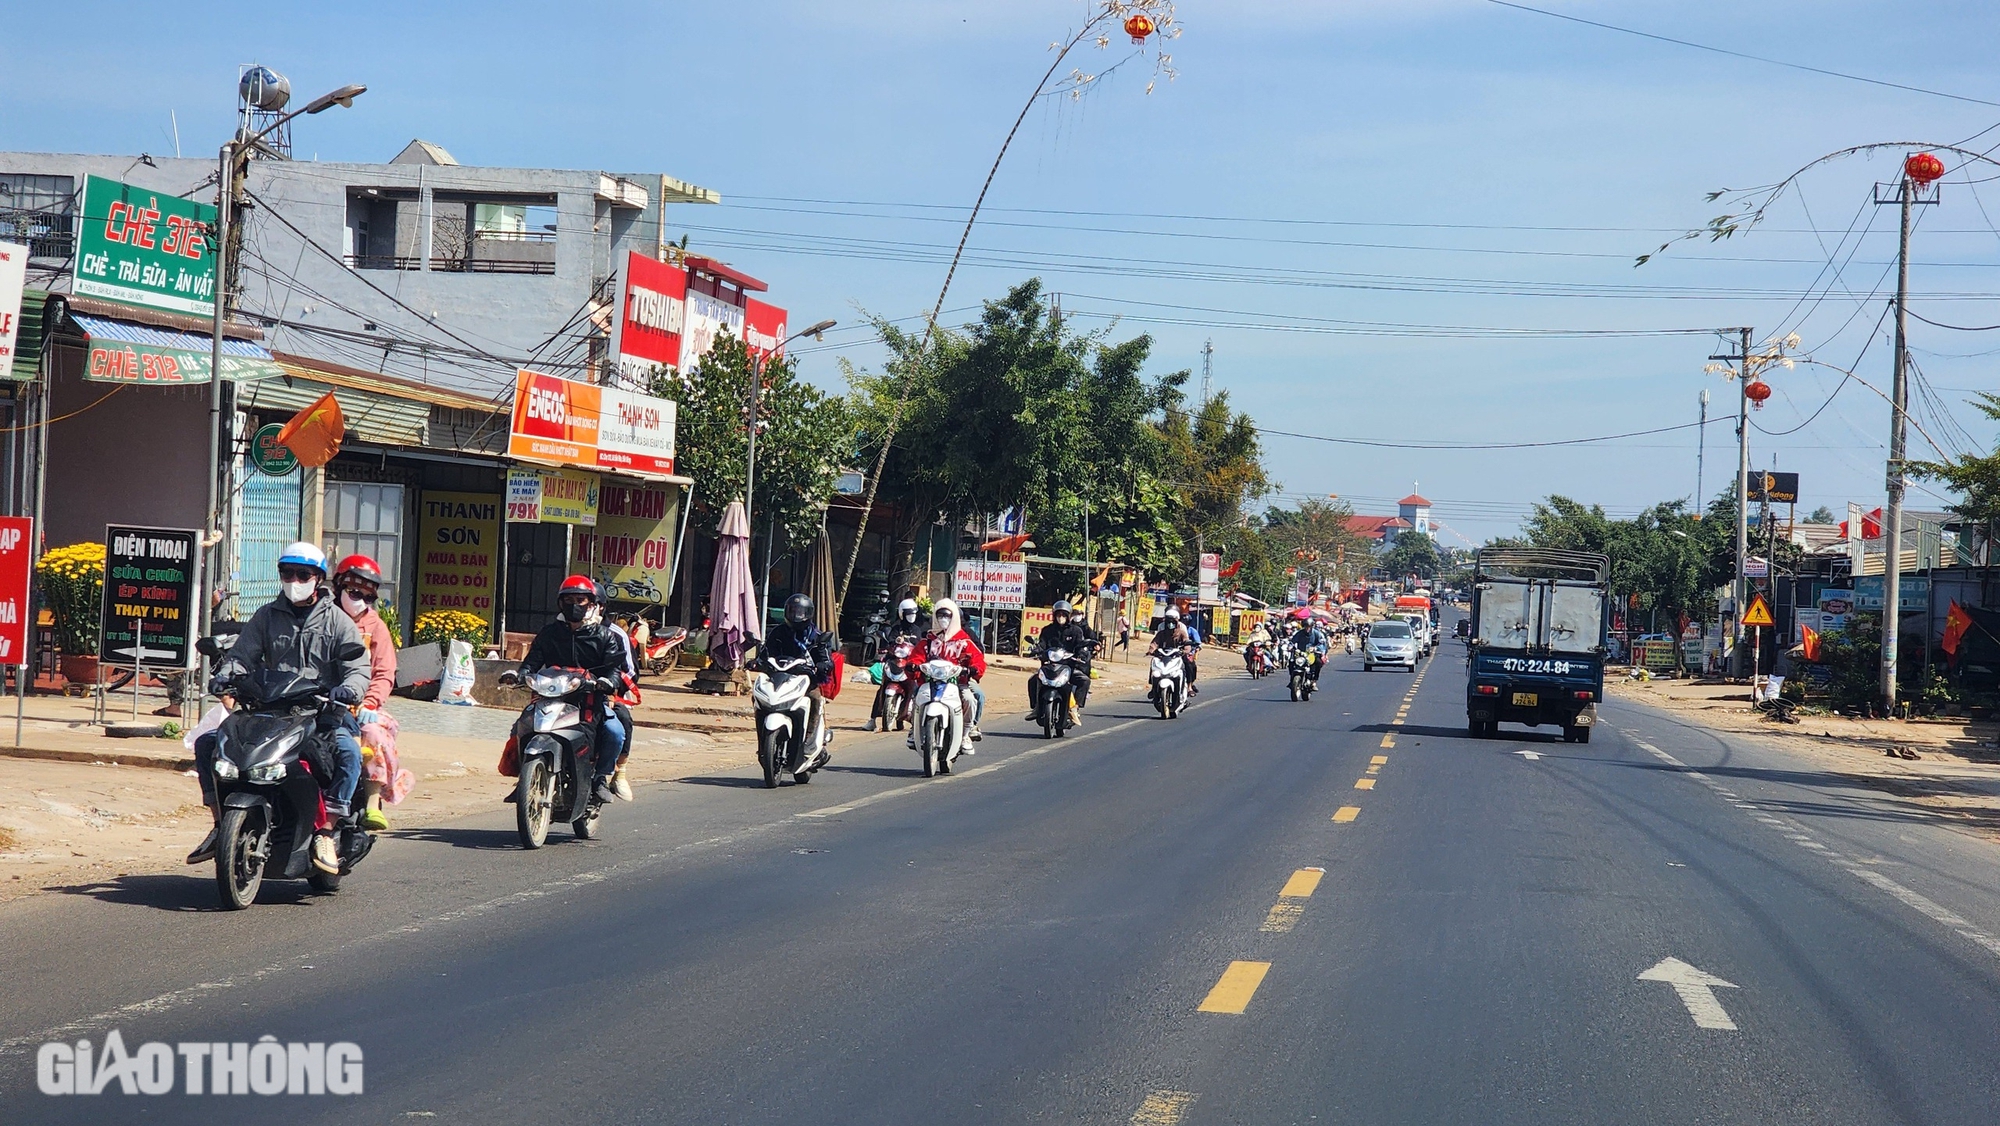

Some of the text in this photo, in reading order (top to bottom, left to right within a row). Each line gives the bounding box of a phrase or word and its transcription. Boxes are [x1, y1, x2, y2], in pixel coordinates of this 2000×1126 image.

[104, 197, 206, 259] CHÈ 312
[82, 253, 109, 276] CHÈ
[117, 259, 140, 284] TRÀ
[141, 262, 167, 288] SỮA
[174, 267, 193, 292] ĂN
[630, 285, 684, 335] TOSHIBA
[91, 346, 138, 380] CHÈ
[142, 354, 183, 381] 312
[527, 386, 566, 425] ENEOS
[618, 403, 643, 428] THANH
[509, 477, 540, 487] BẢO HIỂM
[426, 501, 496, 520] THANH
[507, 502, 538, 519] 79K
[631, 485, 666, 520] BÁN
[0, 529, 21, 554] ẠP
[437, 525, 480, 546] SƠN
[113, 533, 188, 563] ĐIỆN THOẠI
[602, 532, 640, 566] MÁY
[643, 537, 668, 570] CŨ
[427, 552, 456, 565] MUA
[113, 563, 186, 583] SỬA CHỮA
[424, 573, 459, 586] TRAO
[1005, 573, 1023, 585] ĐỊNH
[118, 583, 177, 600] ÉP KÍNH
[421, 593, 437, 606] XE
[114, 603, 179, 619] THAY PIN
[1503, 658, 1570, 674] 47C-224.84
